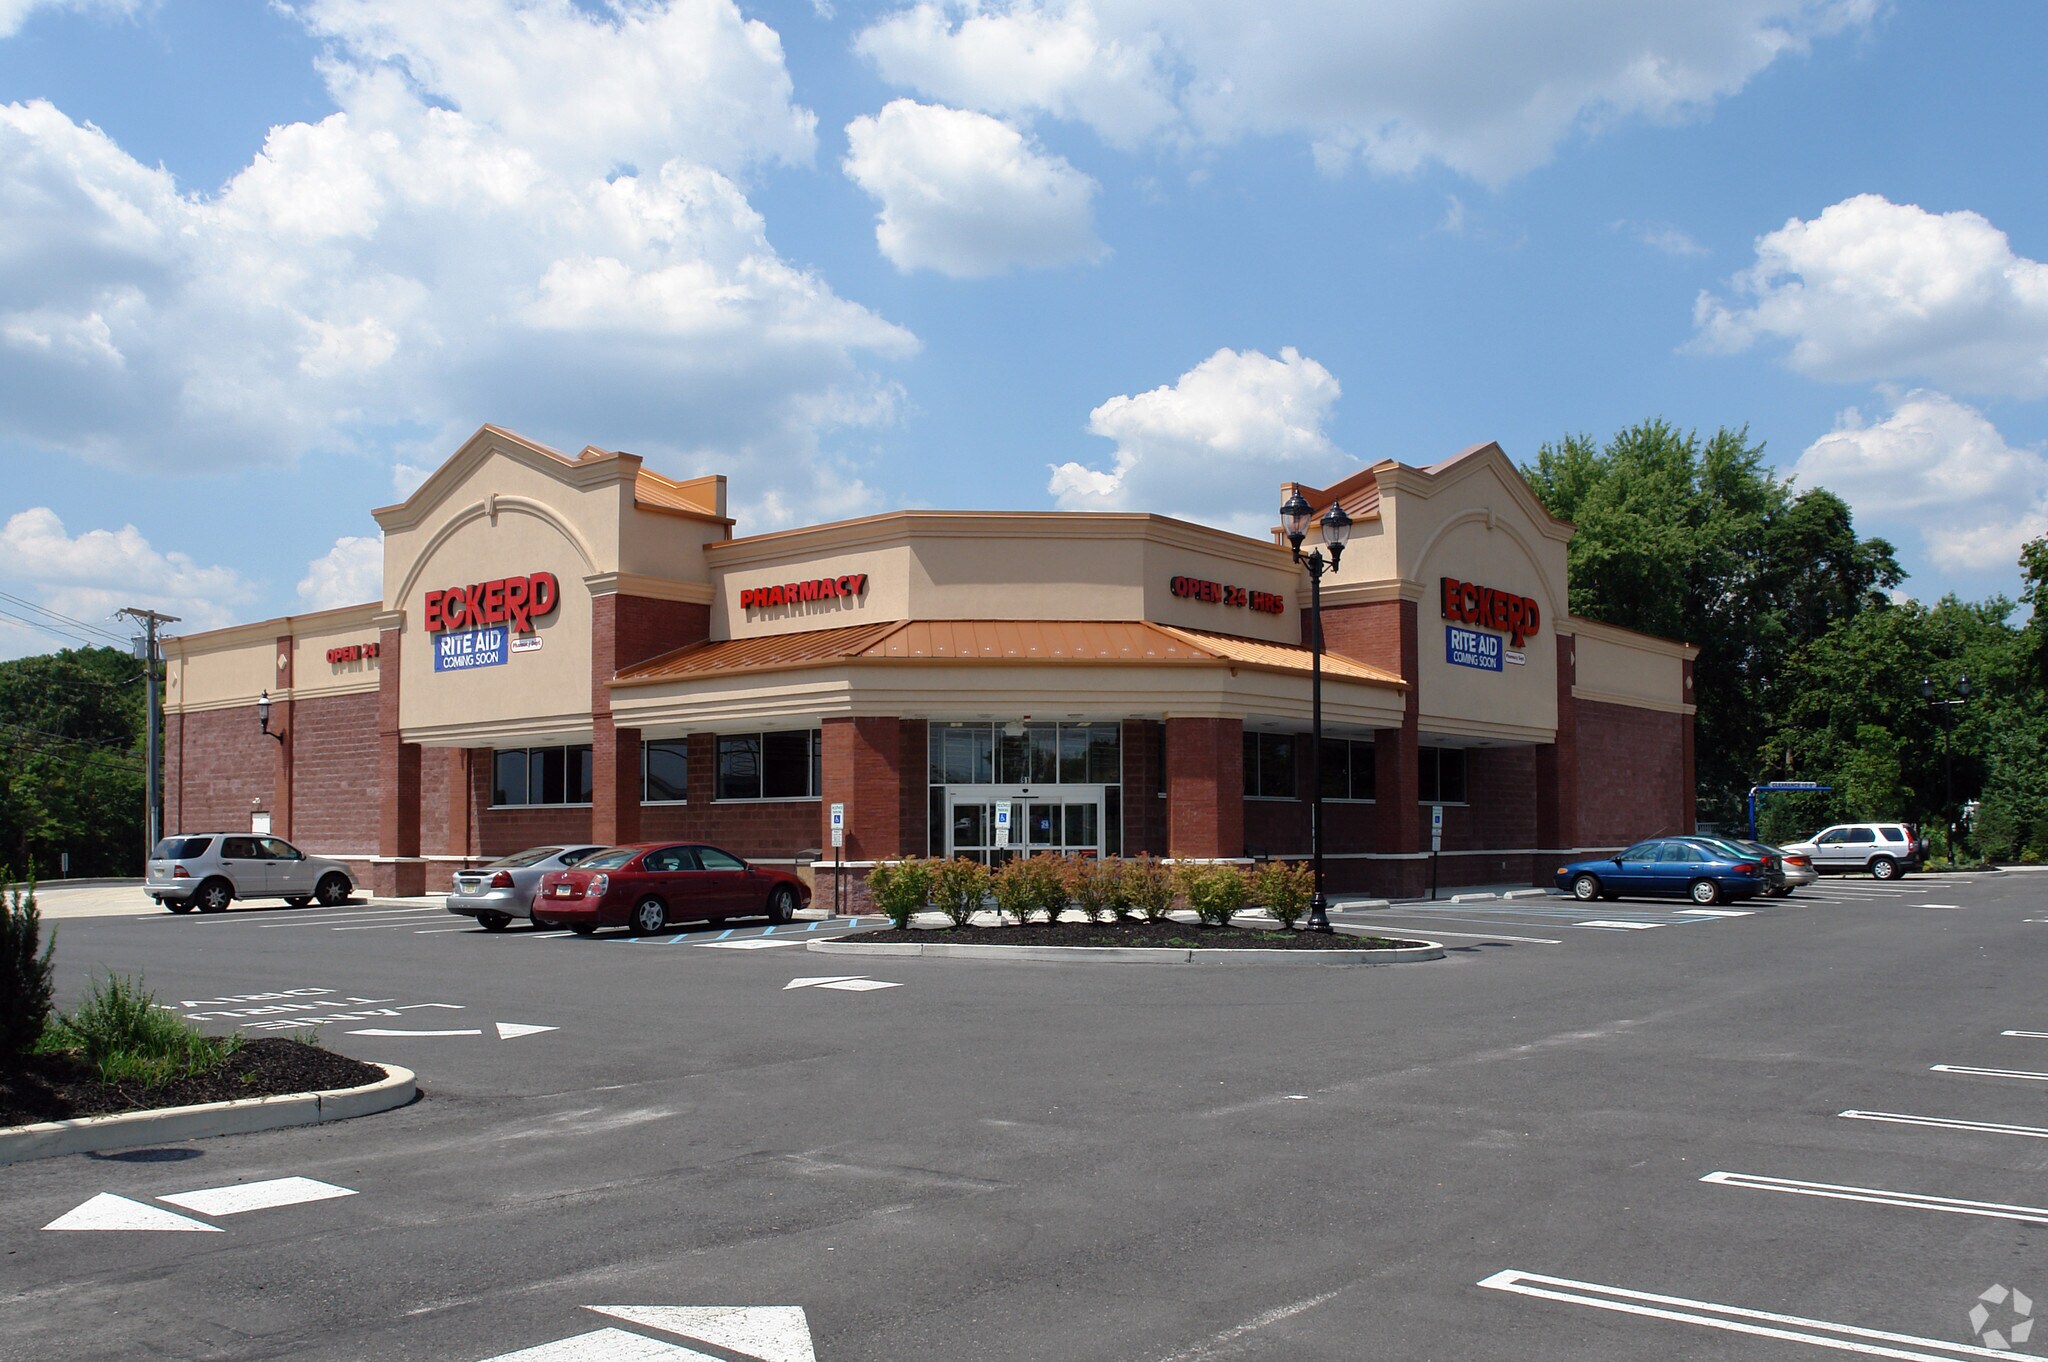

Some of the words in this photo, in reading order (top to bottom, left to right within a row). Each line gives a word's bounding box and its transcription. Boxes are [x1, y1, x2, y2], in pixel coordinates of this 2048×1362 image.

[425, 571, 558, 632] ECKERD
[741, 574, 867, 608] PHARMACY
[1170, 576, 1222, 603] OPEN
[1224, 585, 1247, 607] 24
[1249, 591, 1284, 614] HRS
[1441, 577, 1540, 647] ECKERD
[326, 645, 361, 664] OPEN
[362, 643, 379, 658] 24
[441, 633, 472, 656] RITE
[475, 630, 501, 652] AID
[1451, 629, 1476, 653] RITE
[1479, 635, 1498, 656] AID
[443, 654, 473, 668] COMING
[476, 651, 499, 665] SOON
[1453, 651, 1479, 666] COMING
[1479, 655, 1497, 668] SOON
[183, 997, 395, 1020] THRU
[240, 1002, 466, 1030] LANE
